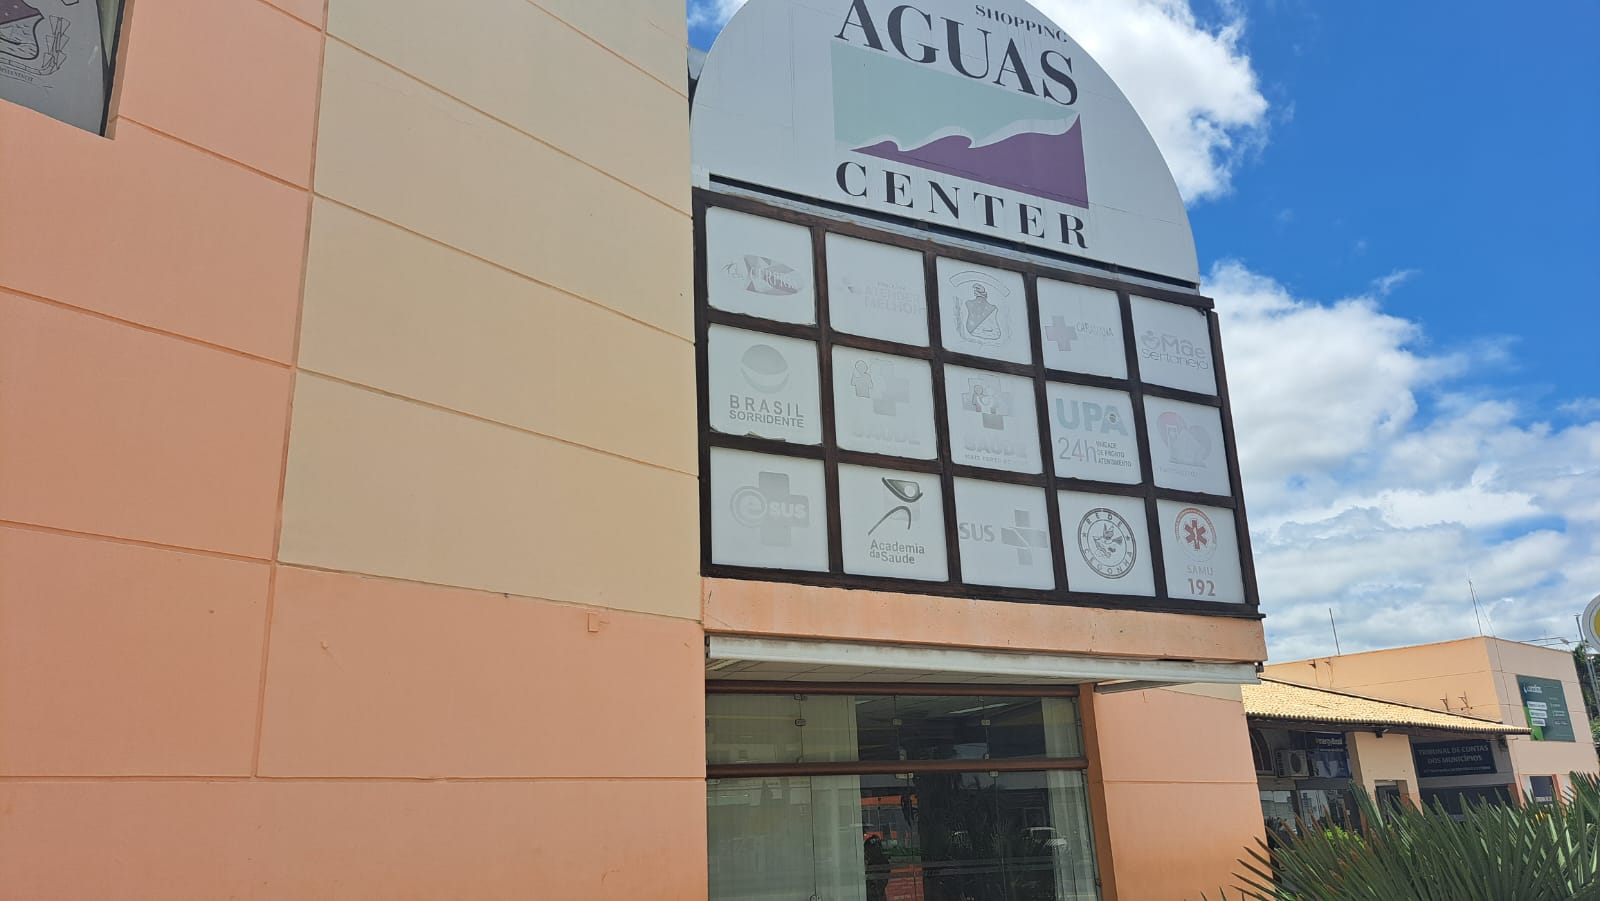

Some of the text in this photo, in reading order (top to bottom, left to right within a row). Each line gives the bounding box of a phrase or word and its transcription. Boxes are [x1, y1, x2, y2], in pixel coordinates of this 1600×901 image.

[975, 4, 1068, 43] SHOPPING
[834, 0, 1078, 105] AGUAS
[836, 161, 1088, 249] CENTER
[729, 394, 805, 418] BRASIL
[1056, 398, 1128, 436] UPA
[729, 409, 805, 428] SORRIDENTE
[1058, 437, 1097, 463] 24h
[1086, 512, 1122, 527] REDE
[959, 521, 995, 543] SUS
[870, 539, 925, 554] Academia
[1186, 564, 1213, 576] SAMU
[1188, 578, 1216, 596] 192
